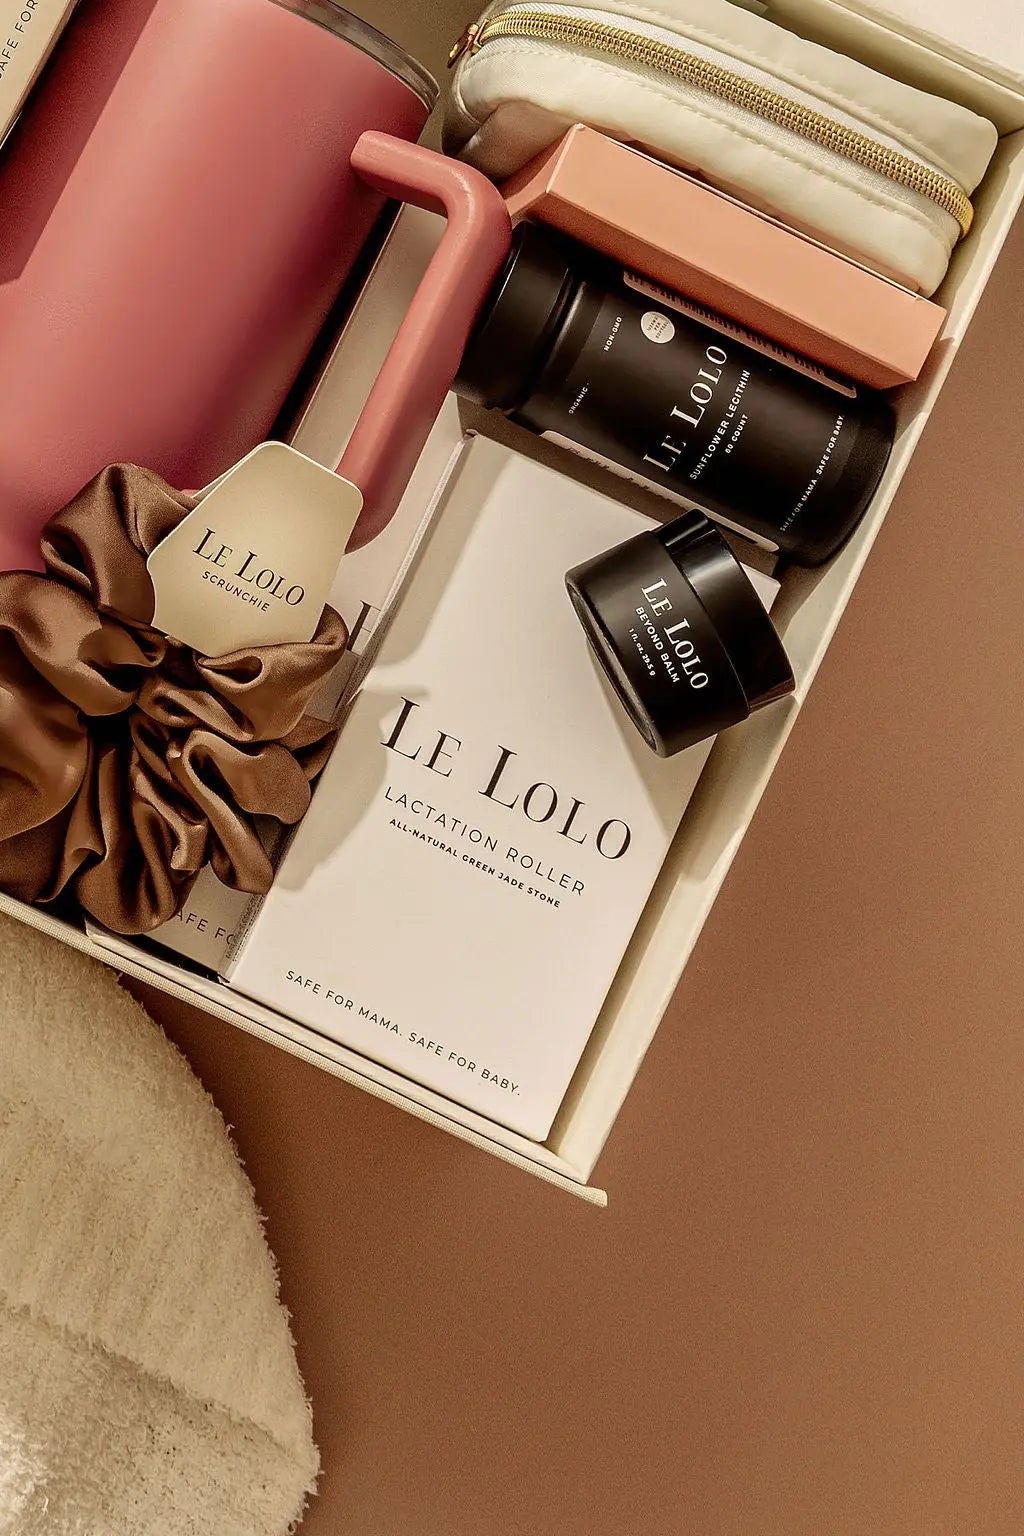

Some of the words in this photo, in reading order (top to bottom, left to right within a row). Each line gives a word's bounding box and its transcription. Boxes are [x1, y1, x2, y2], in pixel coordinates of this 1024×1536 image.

[15, 0, 38, 32] FOR
[568, 386, 588, 414] ORGANIC
[643, 435, 686, 472] LE
[670, 346, 727, 428] LOLO
[689, 420, 729, 480] SUNFLOWER
[726, 370, 751, 418] LECITHIN
[732, 414, 748, 441] COUNT
[816, 454, 830, 475] SAFE
[826, 436, 837, 453] FOR
[192, 528, 233, 568] LE
[236, 549, 306, 608] LOLO
[202, 571, 269, 611] SCRUNCHIE
[635, 606, 663, 651] BEYOND
[661, 652, 680, 683] BALM
[641, 578, 674, 617] LE
[664, 618, 709, 689] LOLO
[380, 696, 463, 778] LE
[478, 745, 632, 861] LOLO
[385, 787, 497, 851] LACTATION
[506, 847, 584, 895] ROLLER
[390, 819, 457, 857] ALL-NATURAL
[463, 855, 495, 875] GREEN
[498, 873, 524, 889] JADE
[527, 888, 560, 907] STONE
[286, 971, 321, 994] SAFE
[326, 990, 353, 1010] FOR
[359, 1007, 401, 1036] MAMA.
[409, 1033, 443, 1056] SAFE
[448, 1052, 476, 1072] FOR
[481, 1069, 519, 1095] BABY.
